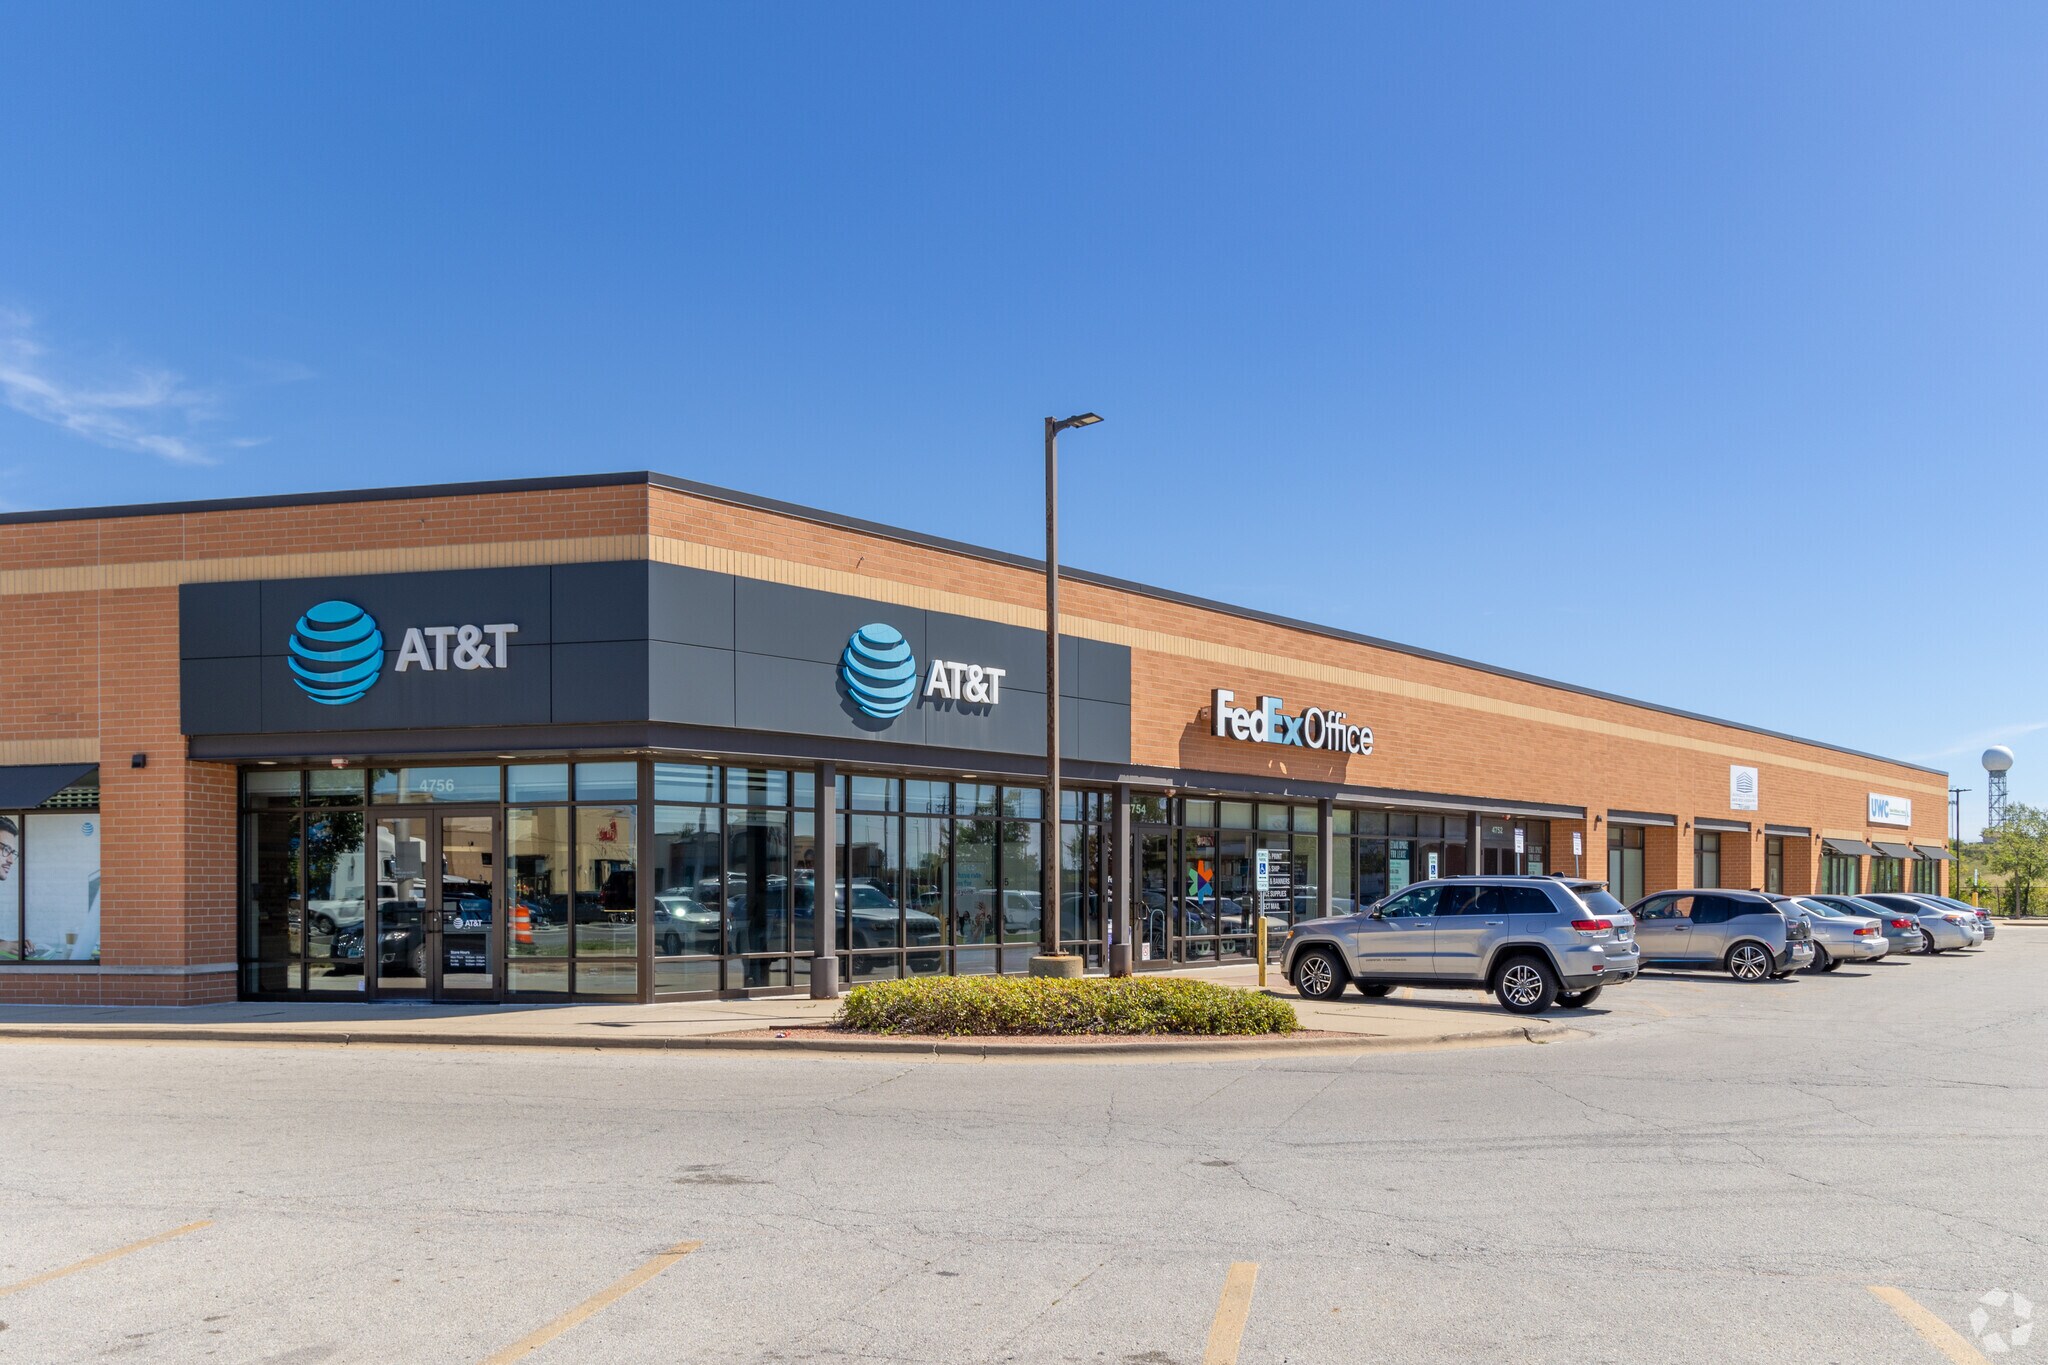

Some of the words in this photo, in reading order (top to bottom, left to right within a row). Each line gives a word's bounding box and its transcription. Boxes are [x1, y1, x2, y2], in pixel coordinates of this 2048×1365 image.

[394, 623, 519, 672] AT&T
[922, 659, 1006, 705] AT&T
[1211, 688, 1304, 747] FedEx
[1301, 706, 1375, 756] Office
[419, 779, 455, 792] 4756
[1129, 803, 1147, 815] 754
[1871, 798, 1889, 818] UWC
[1491, 826, 1504, 834] 4752
[465, 919, 483, 927] AT&T
